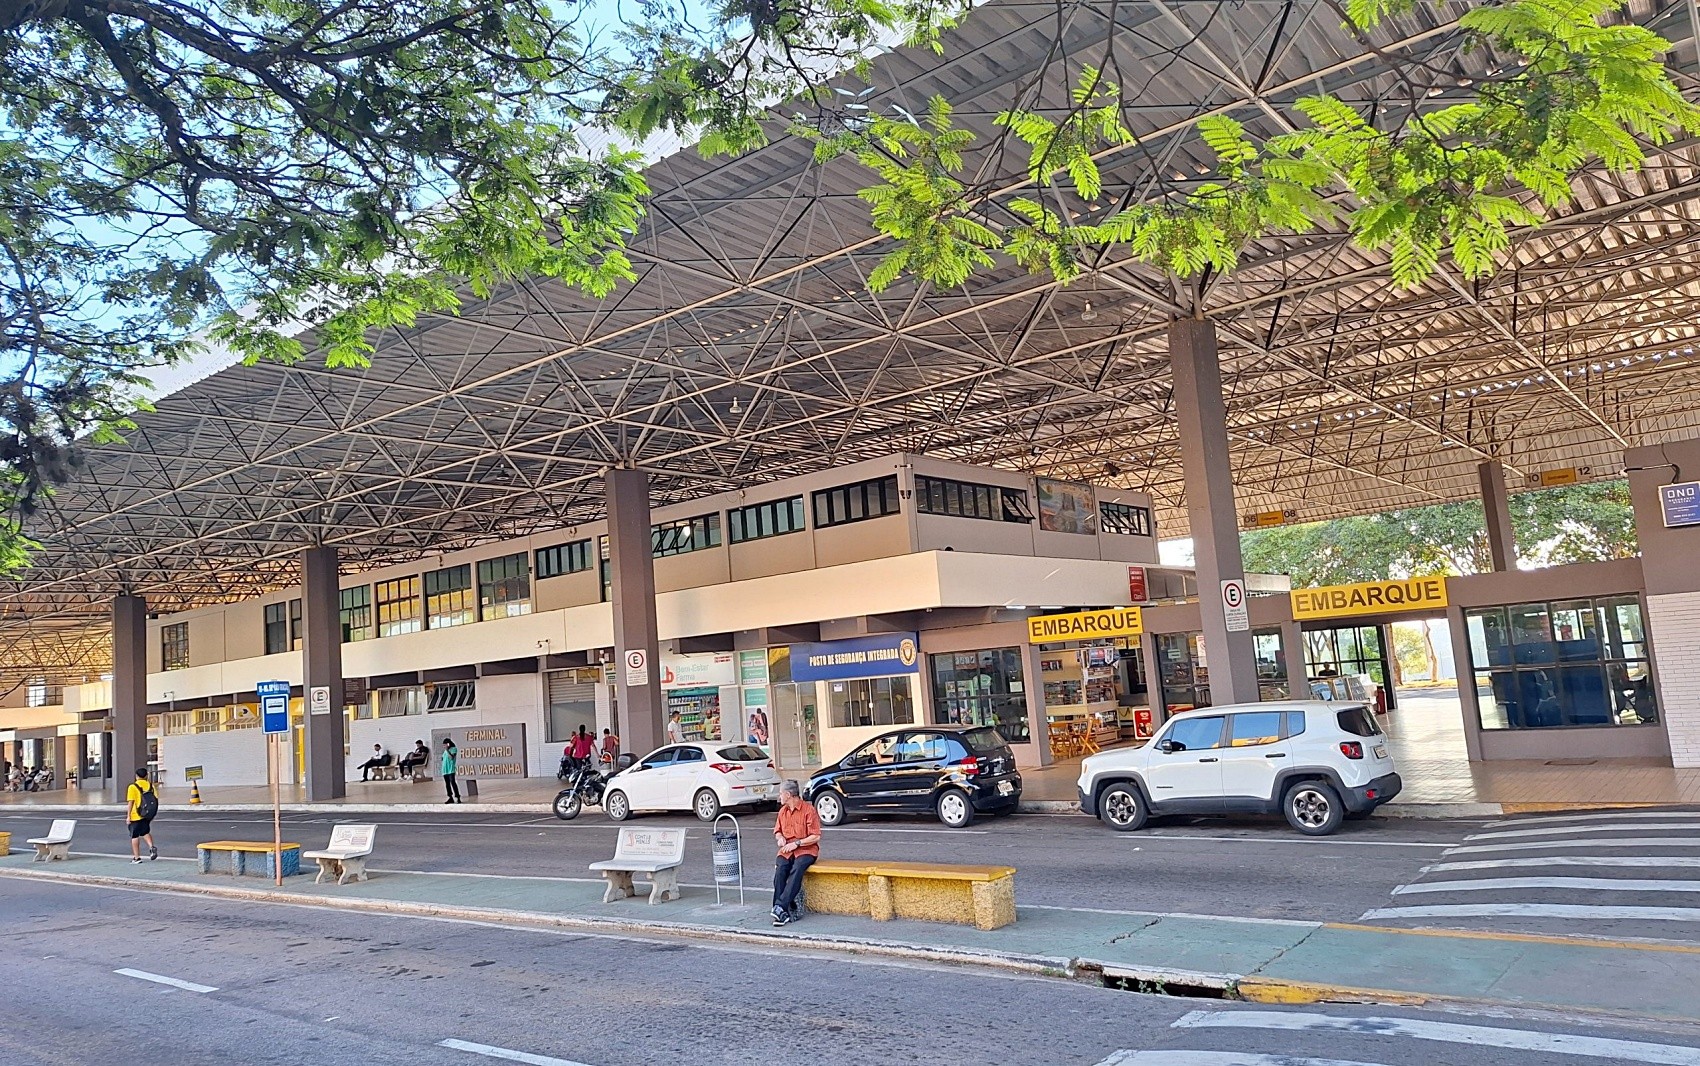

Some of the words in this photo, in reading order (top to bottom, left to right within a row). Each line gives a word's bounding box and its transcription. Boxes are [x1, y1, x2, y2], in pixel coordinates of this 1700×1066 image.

[1578, 466, 1591, 475] 12
[1527, 474, 1539, 483] 10
[1667, 488, 1694, 498] ONO
[1244, 515, 1257, 523] 06
[1283, 509, 1296, 518] 08
[1230, 589, 1236, 601] E
[1294, 580, 1442, 613] EMBARQUE
[1032, 612, 1138, 636] EMBARQUE
[632, 655, 639, 665] E
[809, 655, 827, 666] POSTO
[828, 655, 835, 665] DE
[835, 652, 866, 664] SEGURANÇA
[867, 649, 898, 661] INTEGRADA
[316, 691, 324, 702] E
[464, 728, 507, 741] TERMINAL
[460, 746, 513, 759] RODOVIARIO
[479, 763, 522, 776] VARGINHA
